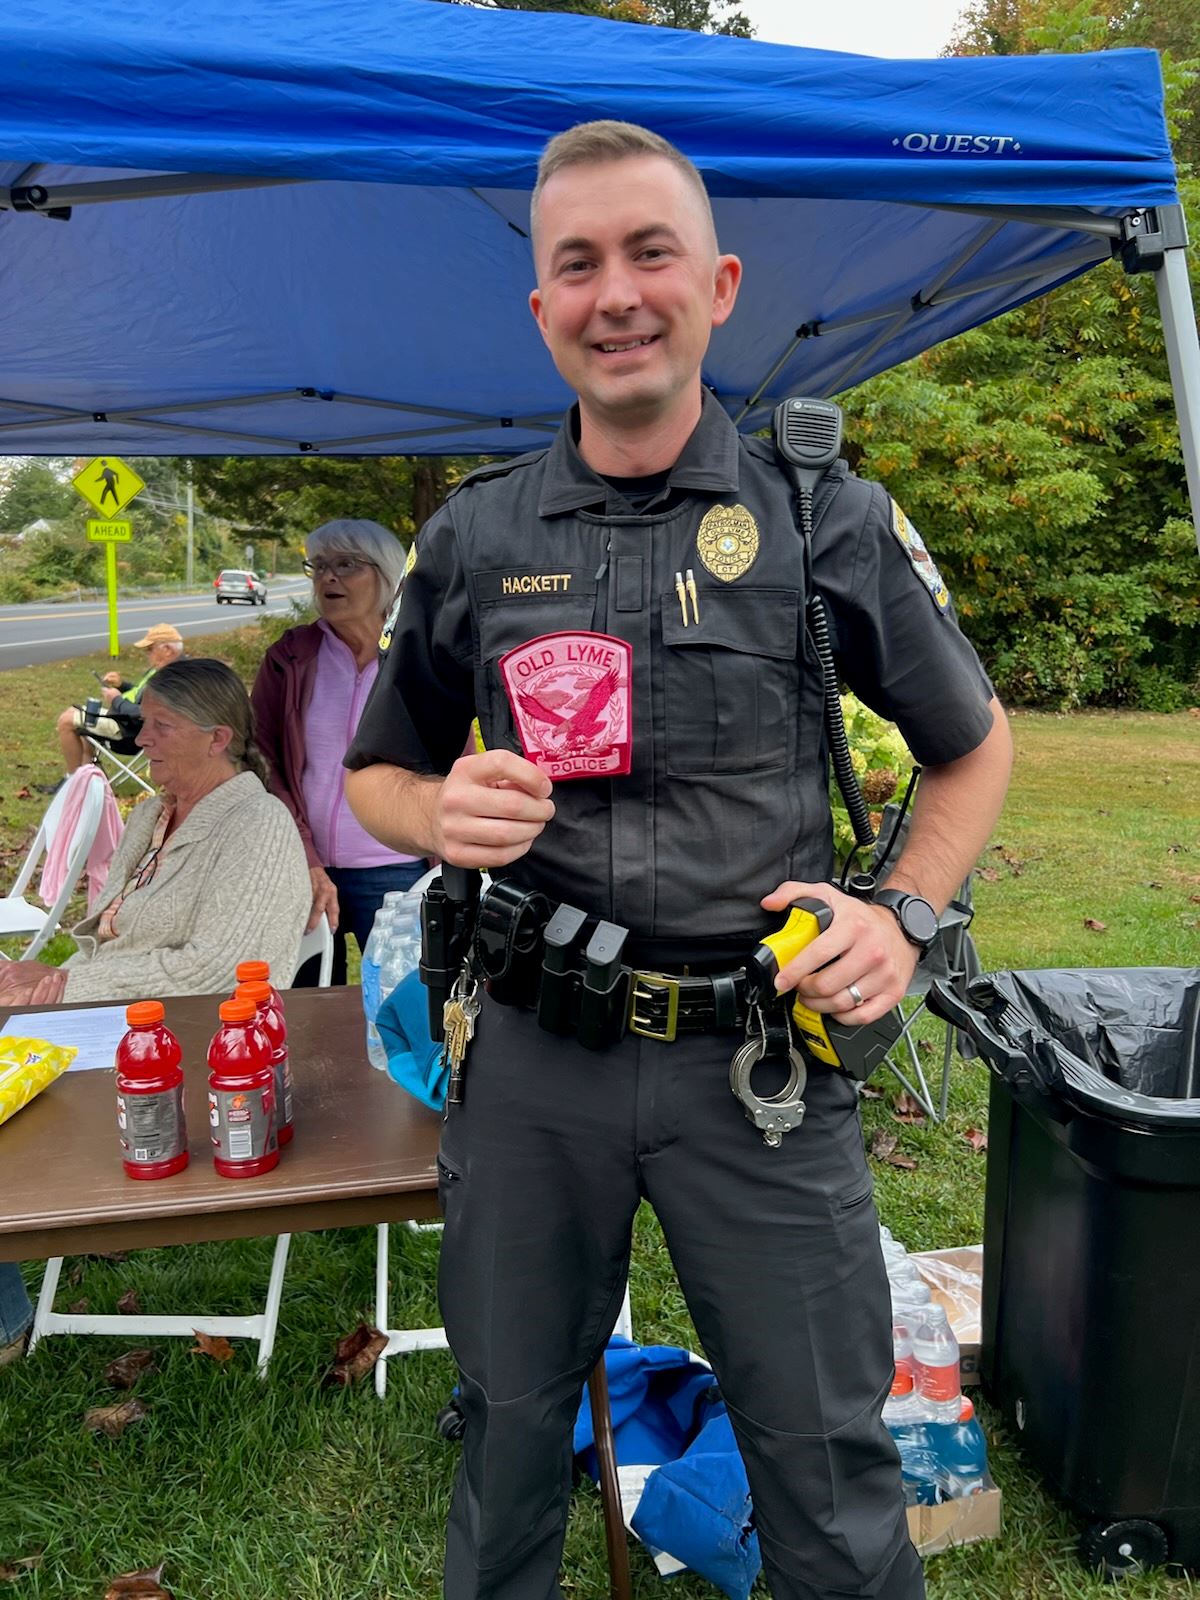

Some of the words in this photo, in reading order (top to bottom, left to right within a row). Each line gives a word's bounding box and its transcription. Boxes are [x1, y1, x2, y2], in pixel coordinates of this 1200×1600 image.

[902, 132, 1014, 154] QUEST
[94, 525, 127, 537] AHEAD
[502, 574, 572, 594] HACKETT
[516, 650, 555, 677] OLD
[567, 644, 615, 668] LYME
[551, 759, 608, 774] POLICE
